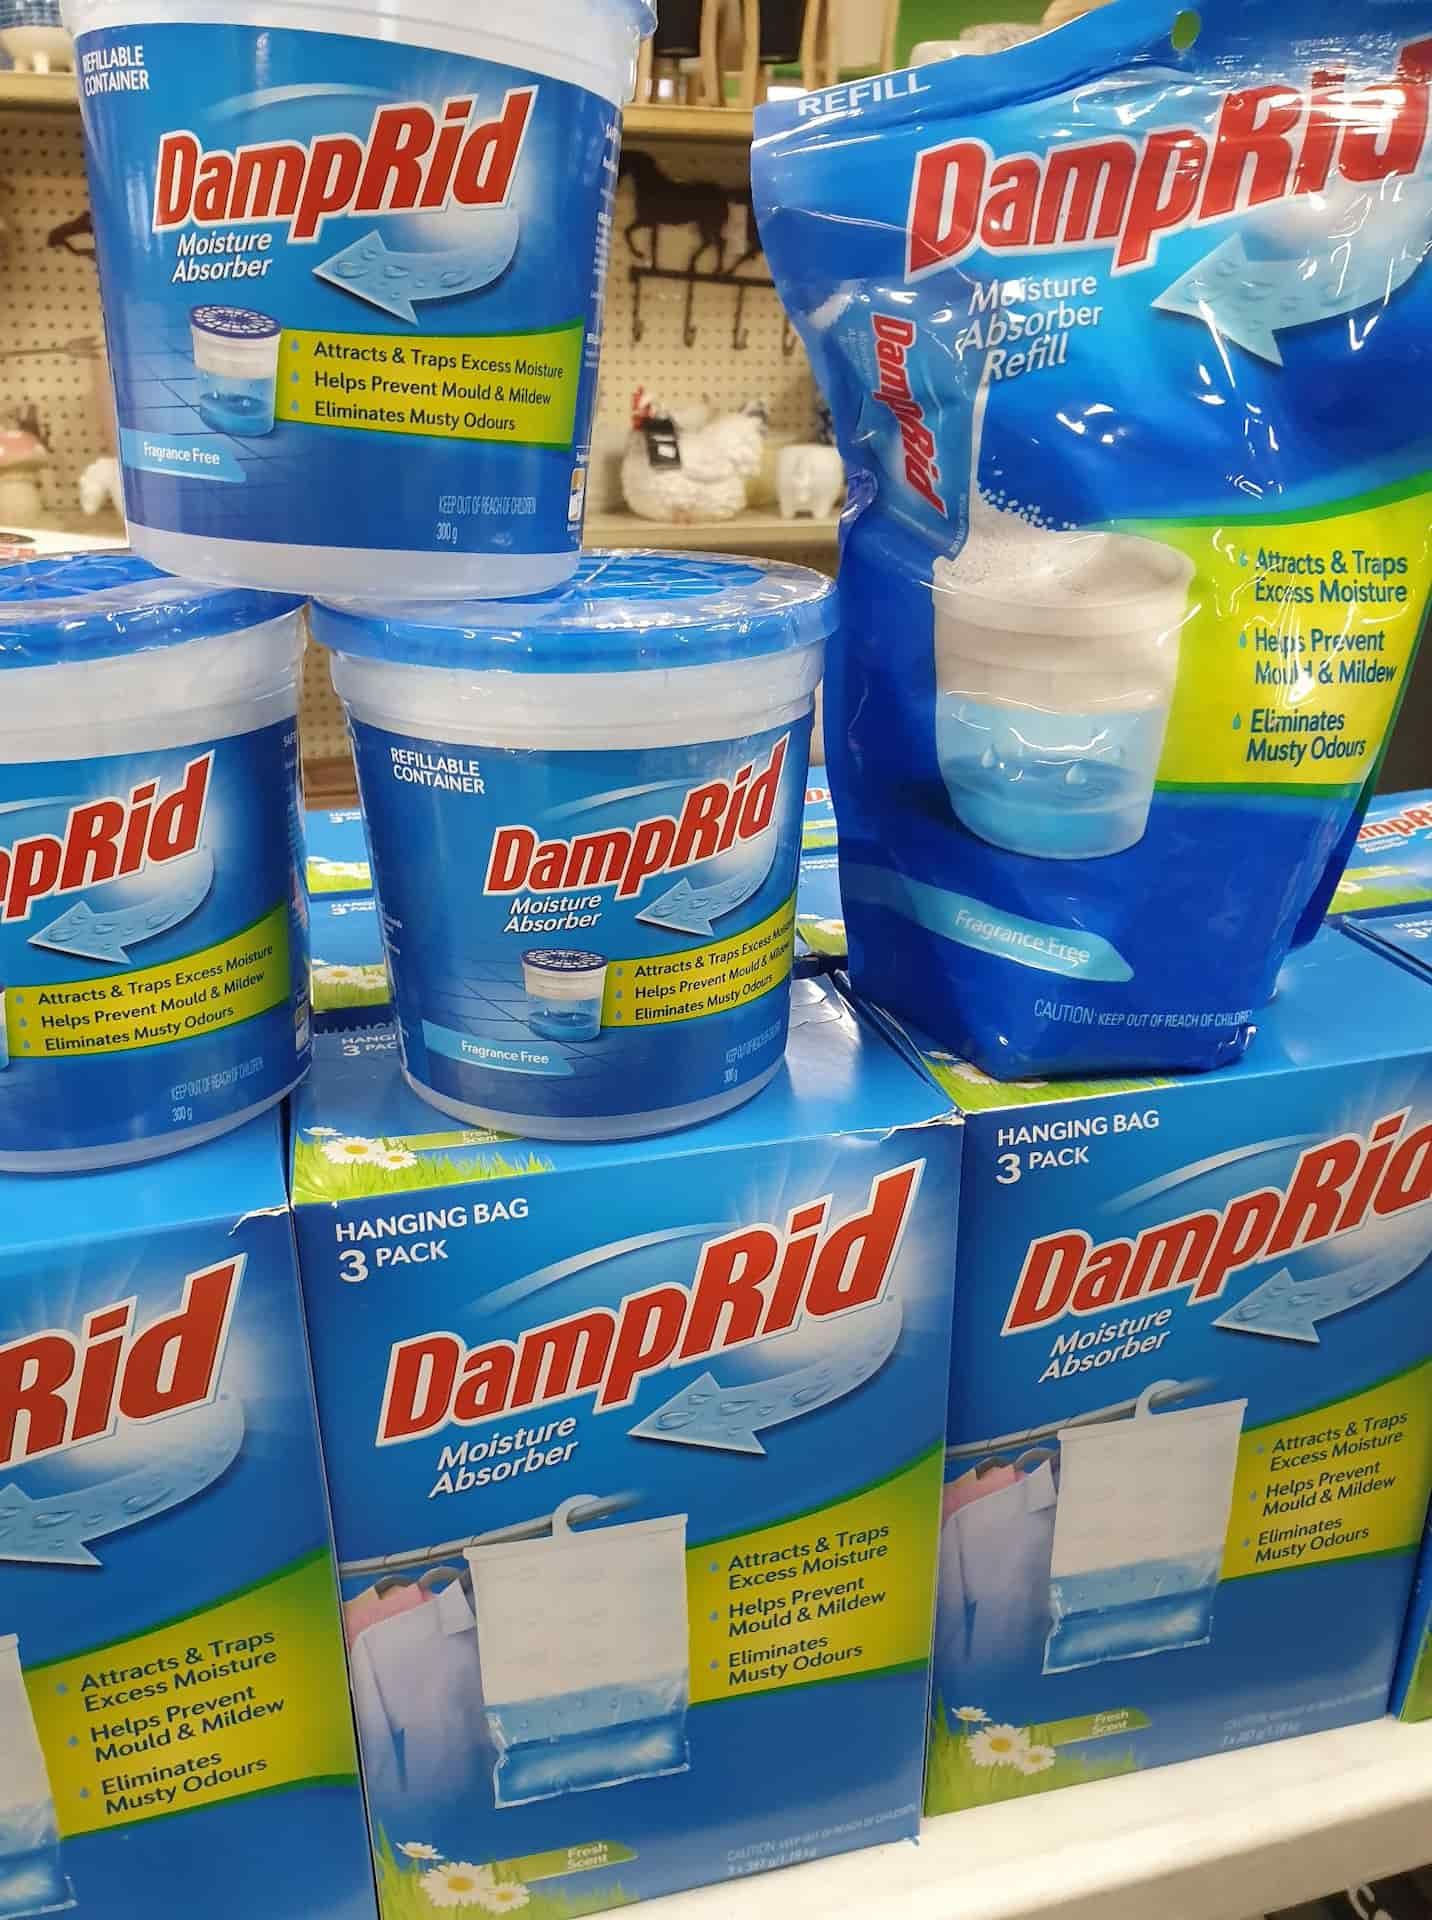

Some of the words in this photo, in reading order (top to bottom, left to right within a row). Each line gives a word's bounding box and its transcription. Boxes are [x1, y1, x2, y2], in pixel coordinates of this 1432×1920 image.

[82, 45, 145, 74] REFILLABLE
[85, 69, 151, 96] CONTAINER
[798, 72, 931, 117] REFILL
[152, 84, 540, 244] DampRid
[176, 230, 273, 258] Moisture
[171, 256, 273, 284] Absorber
[968, 272, 1098, 316] Moisture
[961, 301, 1103, 352] Absorber
[313, 339, 388, 363] Attracts
[392, 345, 406, 365] &
[411, 349, 458, 373] Traps
[461, 353, 512, 374] Excess
[515, 357, 564, 379] Moisture
[983, 331, 1068, 384] Refill
[314, 371, 367, 392] Helps
[372, 375, 438, 397] Prevent
[441, 379, 491, 402] Mould
[494, 384, 505, 402] &
[508, 385, 552, 407] Mildew
[314, 400, 406, 424] Eliminates
[409, 406, 460, 431] Musty
[463, 409, 517, 432] Odours
[143, 441, 191, 464] Fragrance
[192, 446, 221, 465] Free
[1255, 549, 1325, 576] Attracts
[1330, 551, 1348, 575] &
[1352, 551, 1408, 580] Traps
[1254, 579, 1315, 604] Excess
[1318, 579, 1408, 604] Moisture
[1255, 629, 1306, 659] Helps
[1310, 630, 1385, 654] Prevent
[1318, 660, 1334, 684] &
[1338, 658, 1398, 684] Mildew
[1250, 708, 1345, 734] Eliminates
[390, 747, 480, 777] REFILLABLE
[1246, 739, 1307, 768] Musty
[1311, 735, 1367, 761] Odours
[393, 764, 485, 795] CONTAINER
[483, 731, 791, 900] DampRid
[504, 911, 602, 934] Absorber
[510, 893, 602, 917] Moisture
[634, 960, 692, 978] Attracts
[695, 956, 705, 968] &
[708, 948, 740, 966] Traps
[742, 934, 772, 957] Excess
[955, 909, 1044, 951] Fragrance
[1046, 934, 1091, 967] Free
[37, 986, 107, 1006] Attracts
[110, 984, 124, 998] &
[128, 977, 173, 997] Traps
[175, 964, 224, 986] Excess
[226, 944, 274, 972] Moisture
[635, 982, 676, 1000] Helps
[679, 972, 727, 993] Prevent
[729, 959, 760, 980] Mould
[41, 1010, 92, 1030] Helps
[95, 1001, 158, 1024] Prevent
[160, 989, 208, 1012] Mould
[211, 986, 222, 1001] &
[223, 971, 266, 996] Mildew
[635, 1000, 704, 1021] Eliminates
[707, 988, 741, 1009] Musty
[743, 972, 773, 995] Odours
[44, 1030, 131, 1053] Eliminates
[134, 1019, 183, 1044] Musty
[185, 1004, 235, 1029] Odours
[1098, 1012, 1123, 1026] KEEP
[1126, 1013, 1149, 1027] OUT
[1150, 1013, 1166, 1027] OF
[1166, 1013, 1200, 1028] REACH
[1200, 1013, 1215, 1027] OF
[461, 1039, 519, 1064] Fragrance
[519, 1049, 549, 1067] Free
[997, 1117, 1108, 1147] HANGING
[1113, 1110, 1160, 1133] BAG
[996, 1154, 1021, 1185] 3
[1029, 1146, 1090, 1170] PACK
[336, 1206, 468, 1242] HANGING
[473, 1198, 529, 1225] BAG
[339, 1249, 369, 1283] 3
[376, 1240, 449, 1268] PACK
[376, 1158, 927, 1447] DampRid
[1050, 1307, 1172, 1357] Moisture
[1038, 1330, 1171, 1383] Absorber
[438, 1416, 577, 1470] Moisture
[1270, 1448, 1329, 1472] Excess
[1331, 1431, 1405, 1460] Moisture
[1271, 1427, 1343, 1454] Attracts
[1345, 1421, 1360, 1437] &
[1363, 1411, 1409, 1434] Traps
[427, 1438, 578, 1500] Absorber
[1265, 1477, 1315, 1501] Helps
[1318, 1461, 1382, 1487] Prevent
[1262, 1493, 1318, 1517] Mould
[1320, 1488, 1334, 1505] &
[1336, 1474, 1397, 1501] Mildew
[728, 1543, 811, 1573] Attracts
[814, 1536, 831, 1554] &
[834, 1523, 890, 1550] Traps
[1255, 1541, 1306, 1565] Musty
[1309, 1526, 1370, 1550] Odours
[1257, 1517, 1343, 1546] Eliminates
[728, 1563, 798, 1592] Excess
[802, 1542, 889, 1577] Moisture
[728, 1597, 787, 1621] Helps
[791, 1576, 866, 1605] Prevent
[728, 1611, 793, 1638] Mould
[796, 1606, 812, 1624] &
[815, 1589, 887, 1620] Mildew
[80, 1650, 181, 1693] Attracts
[186, 1645, 204, 1664] &
[208, 1628, 275, 1660] Traps
[728, 1634, 829, 1668] Eliminates
[728, 1661, 789, 1687] Musty
[792, 1643, 864, 1671] Odours
[83, 1679, 170, 1714] Excess
[173, 1649, 278, 1689] Moisture
[89, 1711, 161, 1745] Helps
[165, 1685, 257, 1722] Prevent
[94, 1728, 174, 1763] Mould
[177, 1723, 196, 1741] &
[200, 1697, 286, 1731] Mildew
[1091, 1721, 1128, 1736] Scent
[1095, 1710, 1129, 1725] Fresh
[101, 1750, 223, 1797] Eliminates
[105, 1782, 177, 1817] Musty
[181, 1757, 268, 1793] Odours
[567, 1843, 608, 1860] Fresh
[567, 1854, 609, 1869] Scent
